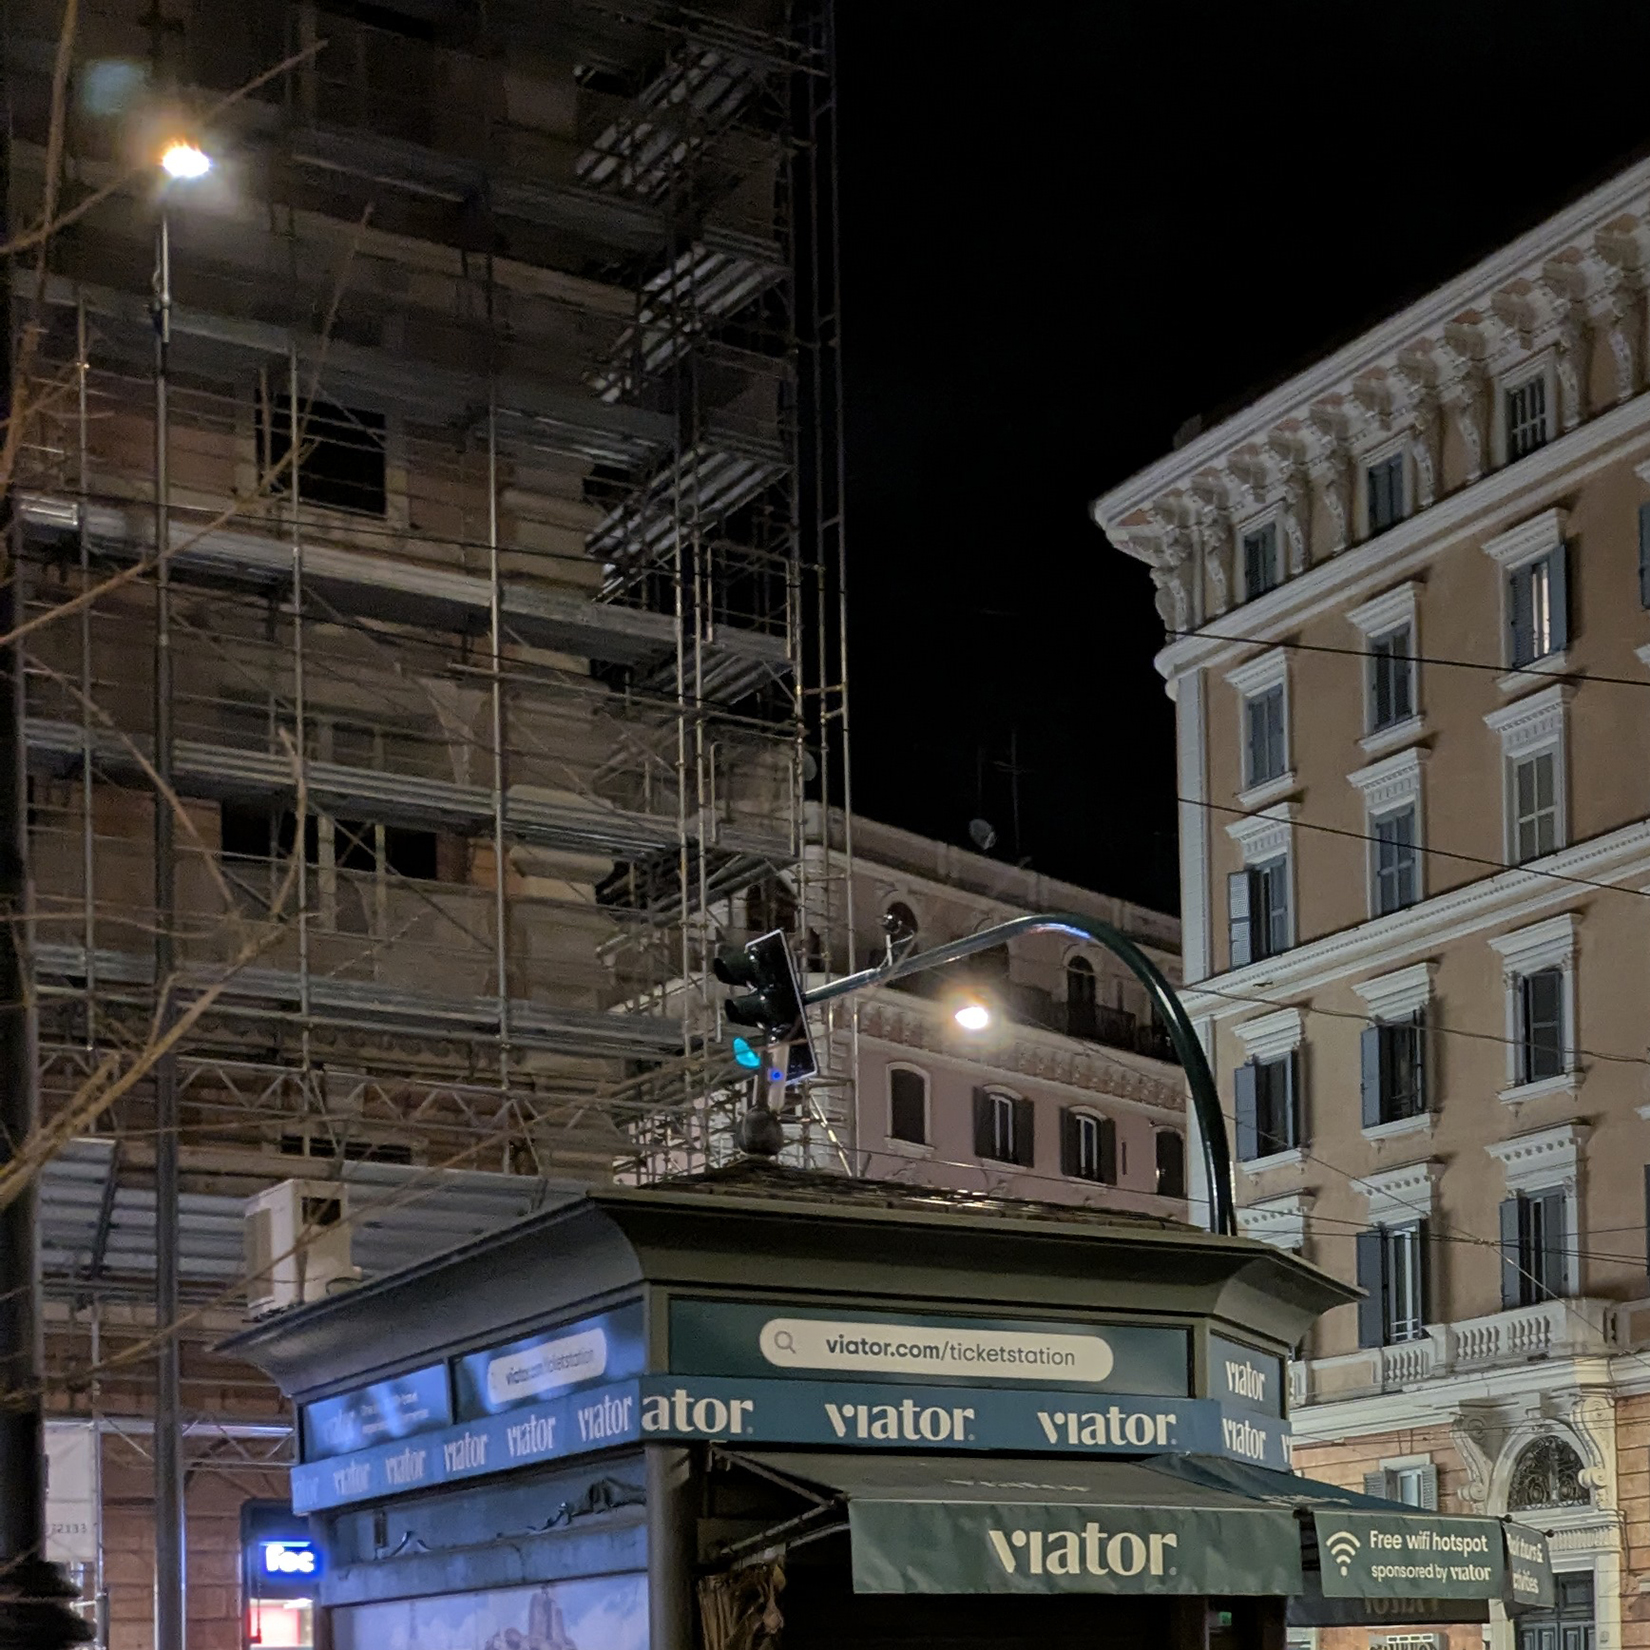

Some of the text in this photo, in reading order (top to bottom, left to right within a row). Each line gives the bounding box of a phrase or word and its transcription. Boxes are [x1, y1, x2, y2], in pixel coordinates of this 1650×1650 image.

[826, 1334, 1075, 1366] viator.com/ticketstation
[1225, 1361, 1265, 1401] viator
[641, 1389, 1177, 1446] ator viator viator
[385, 1446, 426, 1484] viator
[444, 1431, 488, 1473] viator
[507, 1414, 556, 1457] viator
[577, 1394, 632, 1442] viator
[1222, 1418, 1266, 1460] viator
[988, 1522, 1178, 1576] viator
[1370, 1530, 1489, 1557] Free wifi hotspot
[1371, 1564, 1492, 1583] sponsored by viator
